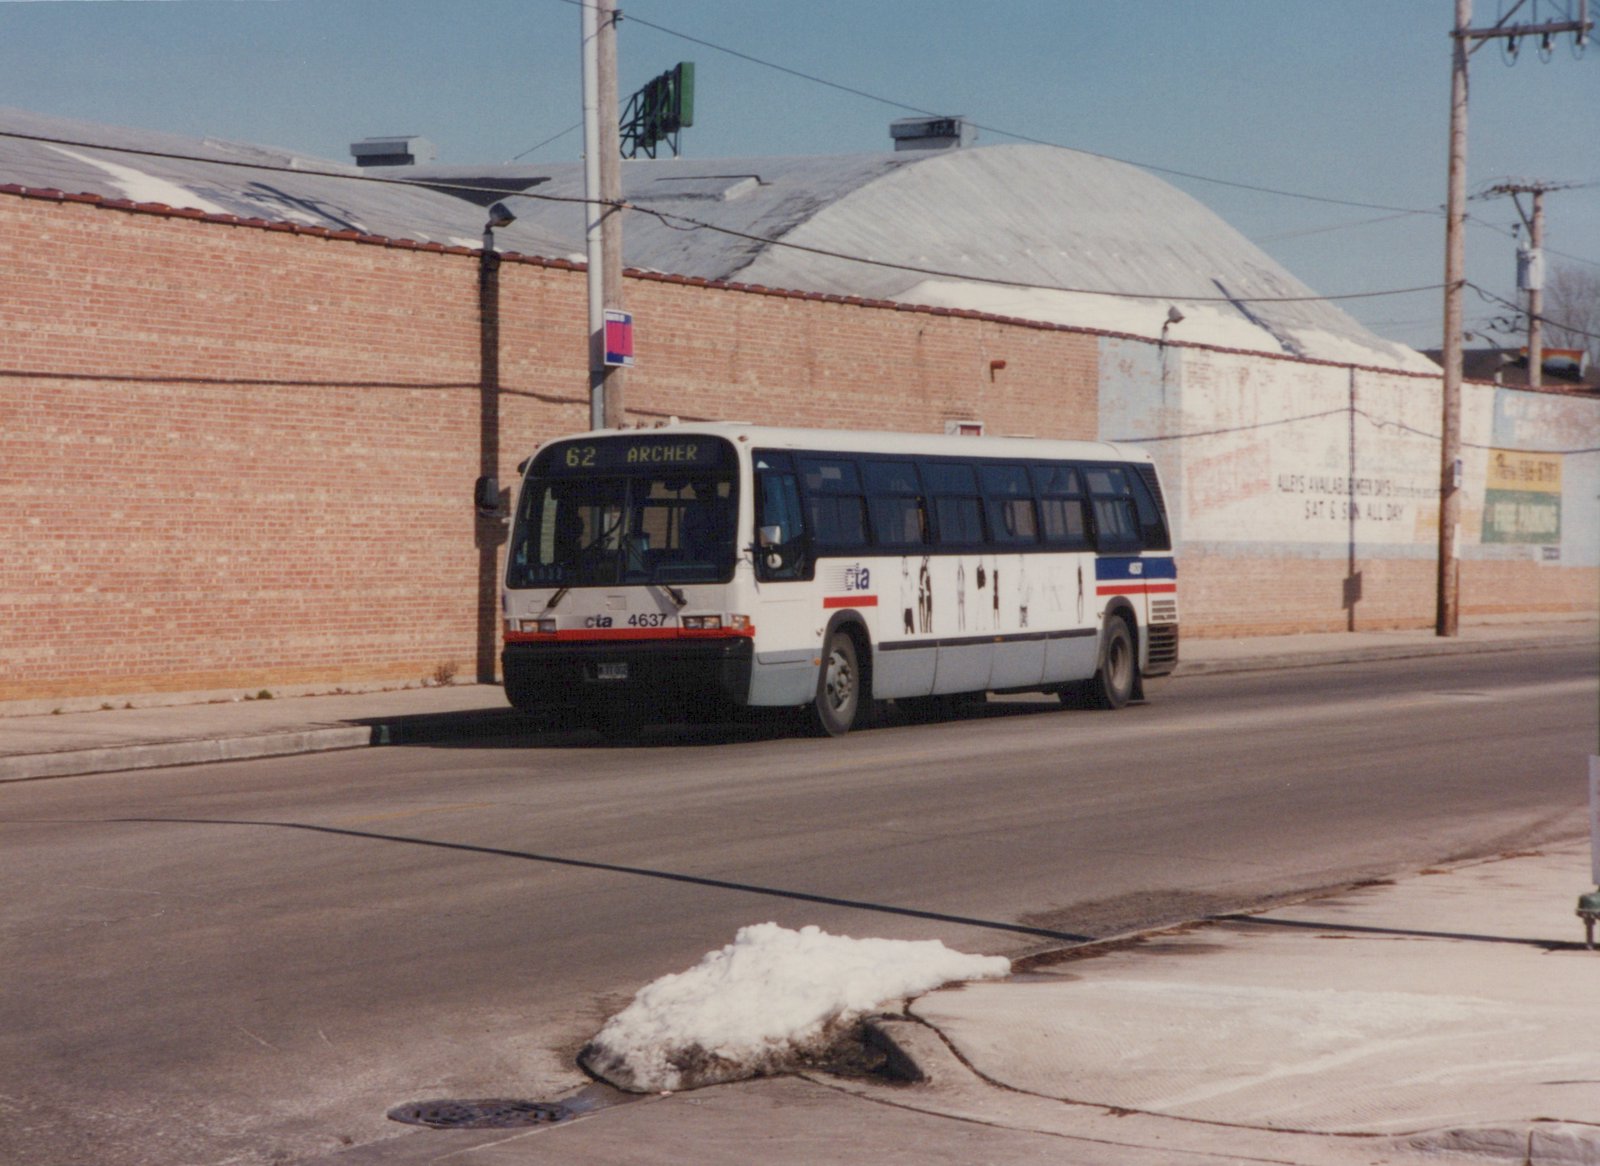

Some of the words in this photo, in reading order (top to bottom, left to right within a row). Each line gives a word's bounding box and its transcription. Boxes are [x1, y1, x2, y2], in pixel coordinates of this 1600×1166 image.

[565, 447, 597, 467] 62
[626, 444, 698, 463] ARCHER
[1304, 500, 1325, 521] SAT
[1366, 502, 1384, 522] ALL
[1385, 503, 1404, 522] DAY
[584, 614, 613, 629] cta
[627, 612, 668, 628] 4637
